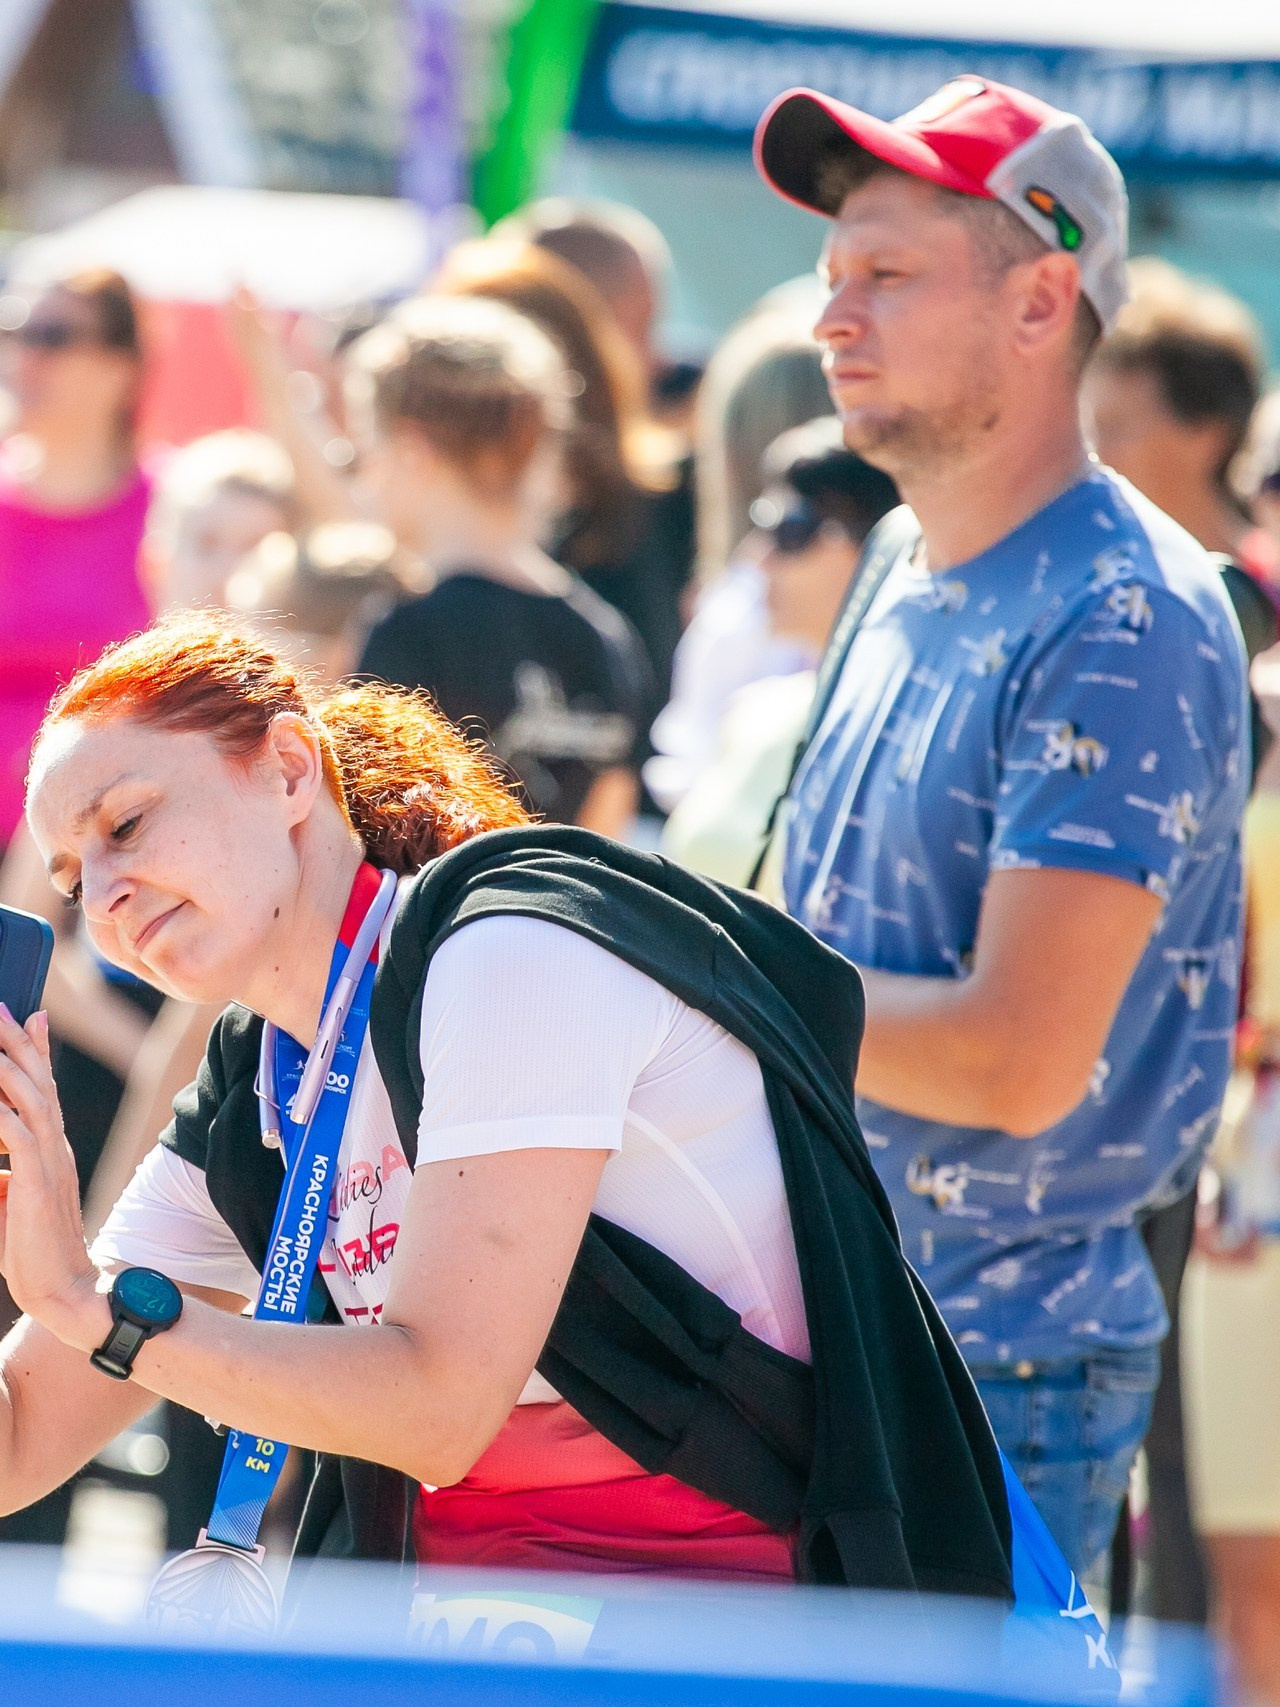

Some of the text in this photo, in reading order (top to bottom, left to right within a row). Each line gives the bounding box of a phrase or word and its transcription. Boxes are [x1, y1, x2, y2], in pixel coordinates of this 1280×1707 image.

[280, 1154, 329, 1315] КРАСНОЯРСКИЕ
[263, 1235, 293, 1311] МОСТЫ
[245, 1456, 271, 1474] КМ
[255, 1438, 275, 1456] 10
